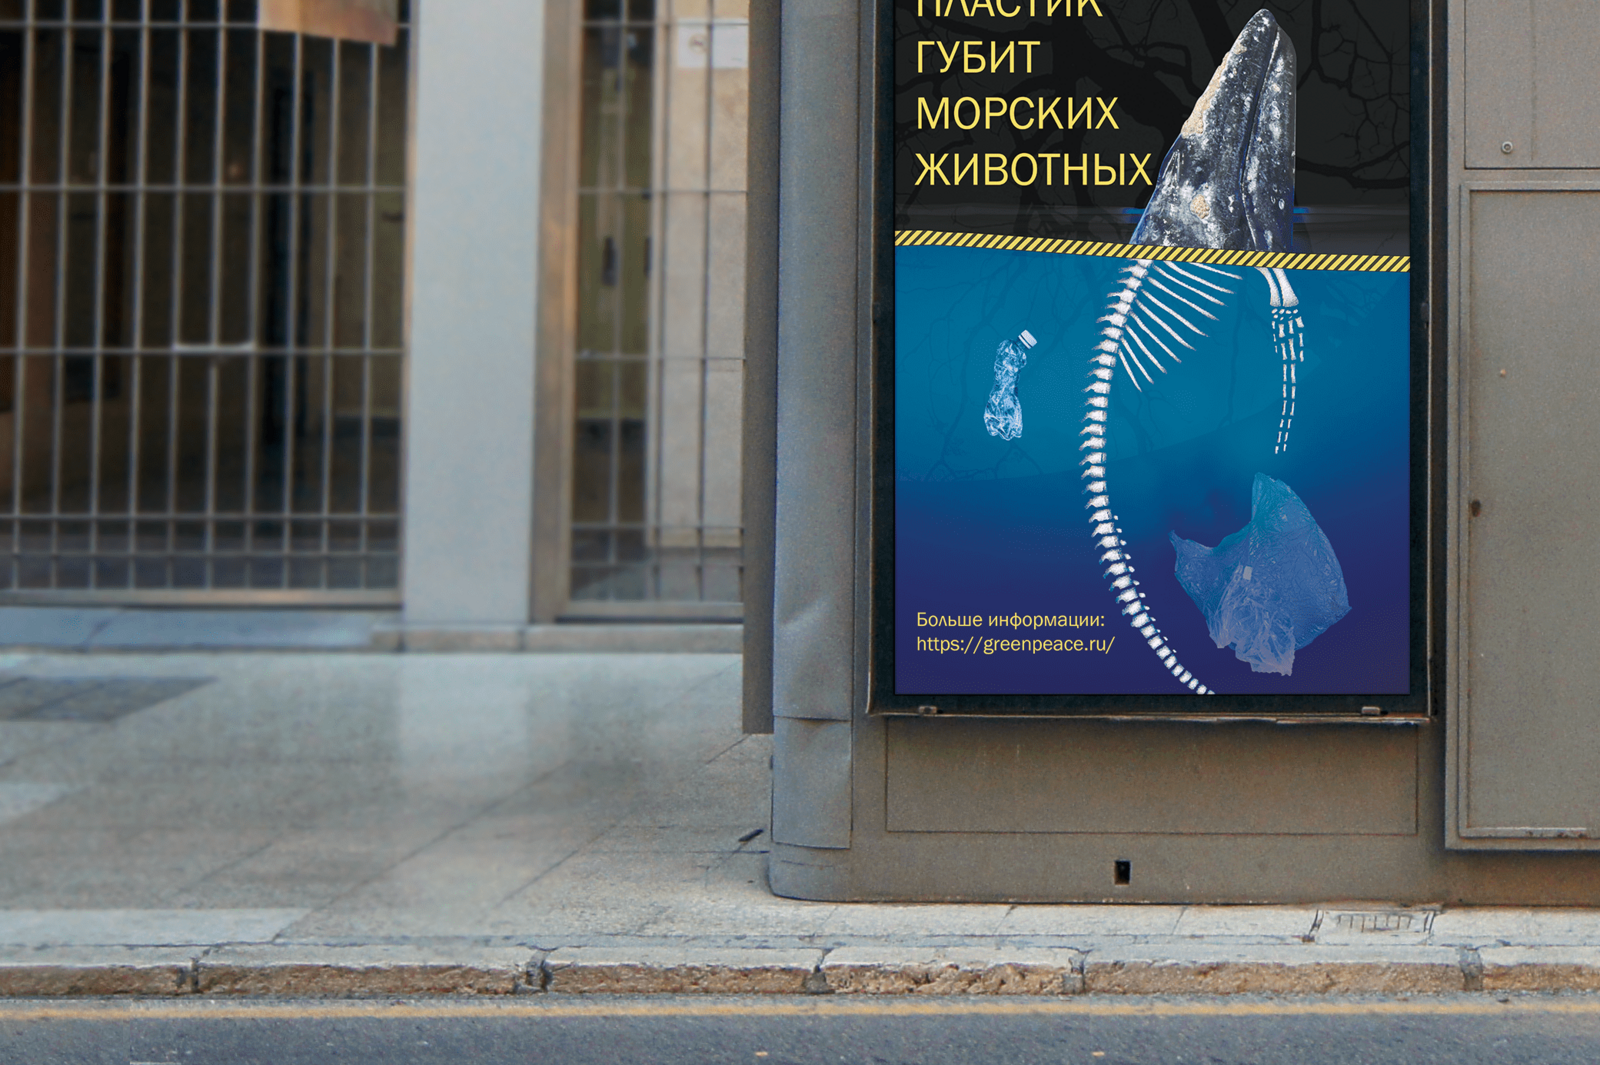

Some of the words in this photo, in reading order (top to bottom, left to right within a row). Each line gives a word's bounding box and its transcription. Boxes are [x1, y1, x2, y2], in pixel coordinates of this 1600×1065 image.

[917, 40, 1041, 74] ГУБИТ
[917, 96, 1120, 130] МОРСКИХ
[914, 152, 1153, 186] ЖИВОТНЫХ
[917, 611, 983, 627] Больше
[988, 612, 1105, 630] информации:
[917, 636, 1116, 655] https://greenpeace.ru/
